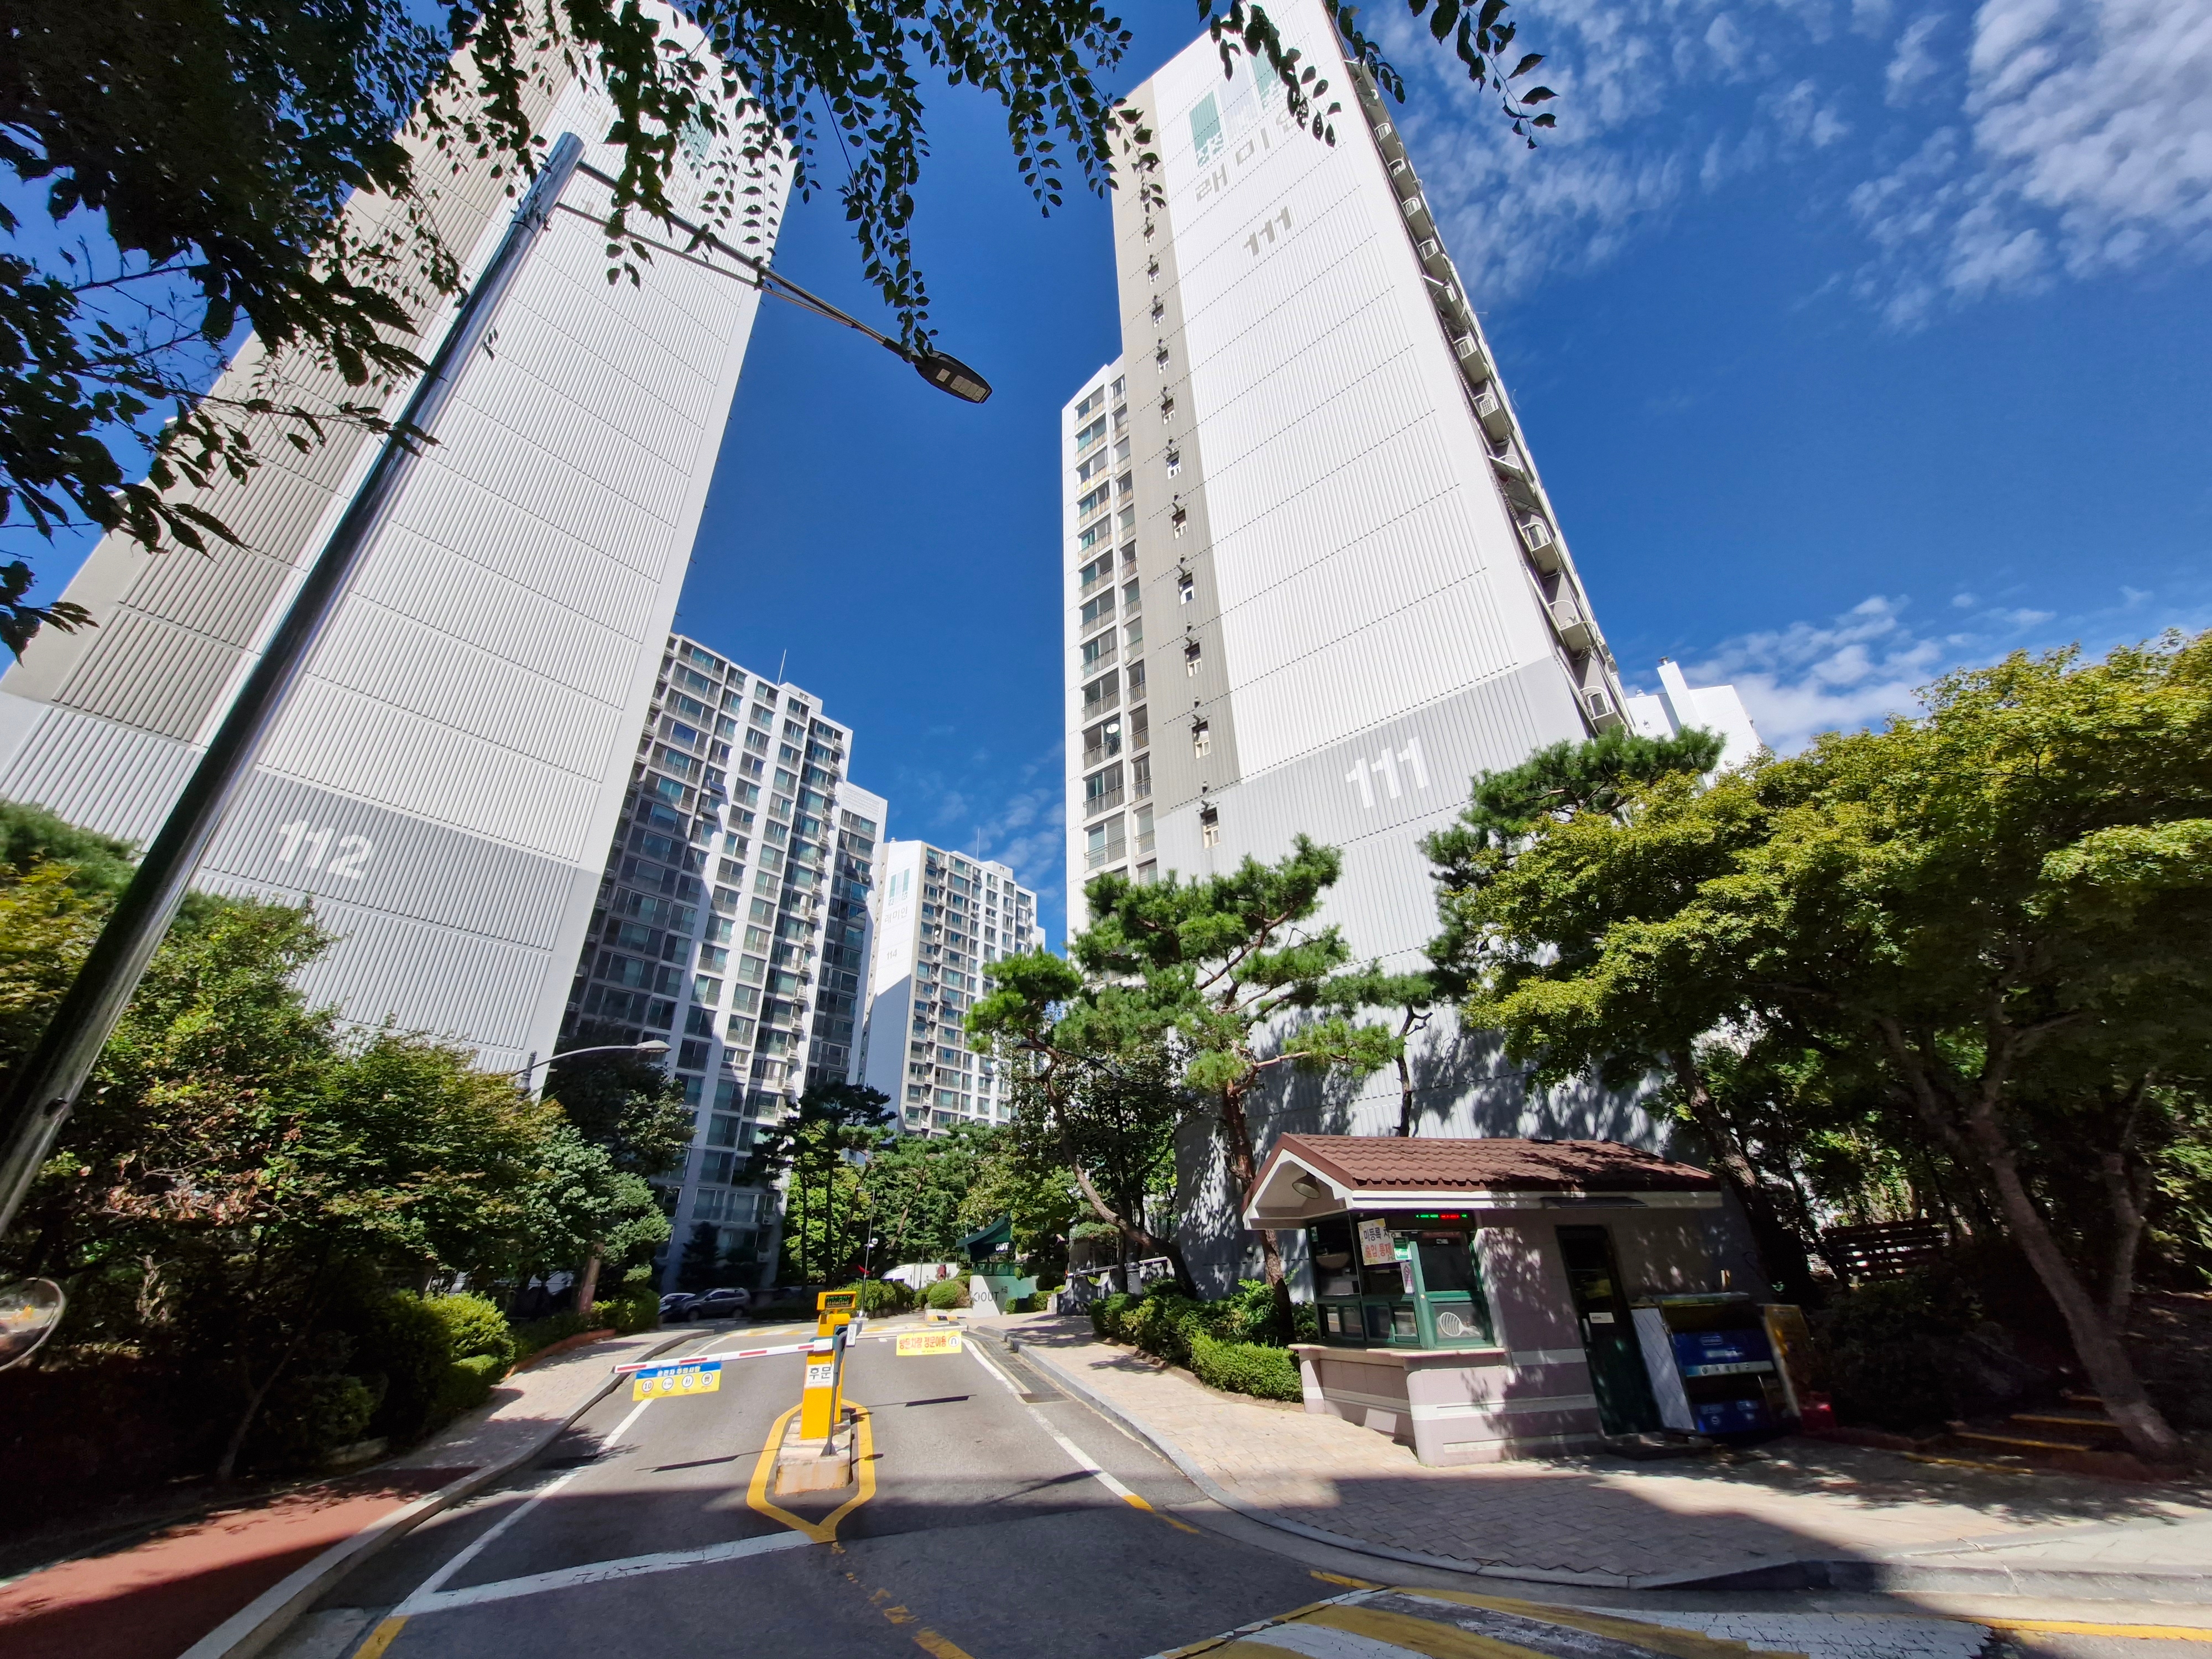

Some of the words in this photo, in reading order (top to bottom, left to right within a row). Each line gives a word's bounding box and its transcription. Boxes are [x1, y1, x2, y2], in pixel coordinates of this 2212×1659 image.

[1242, 206, 1292, 256] 111
[1345, 736, 1430, 808] 111
[278, 818, 373, 879] 112
[887, 948, 897, 959] 114
[1364, 1227, 1381, 1241] 미등록
[995, 1242, 1009, 1251] OUT
[1365, 1244, 1378, 1258] 출입
[980, 1291, 999, 1302] OUT
[924, 1335, 946, 1348] 정문이용
[657, 1369, 675, 1377] 운전자
[809, 1366, 831, 1379] 후문
